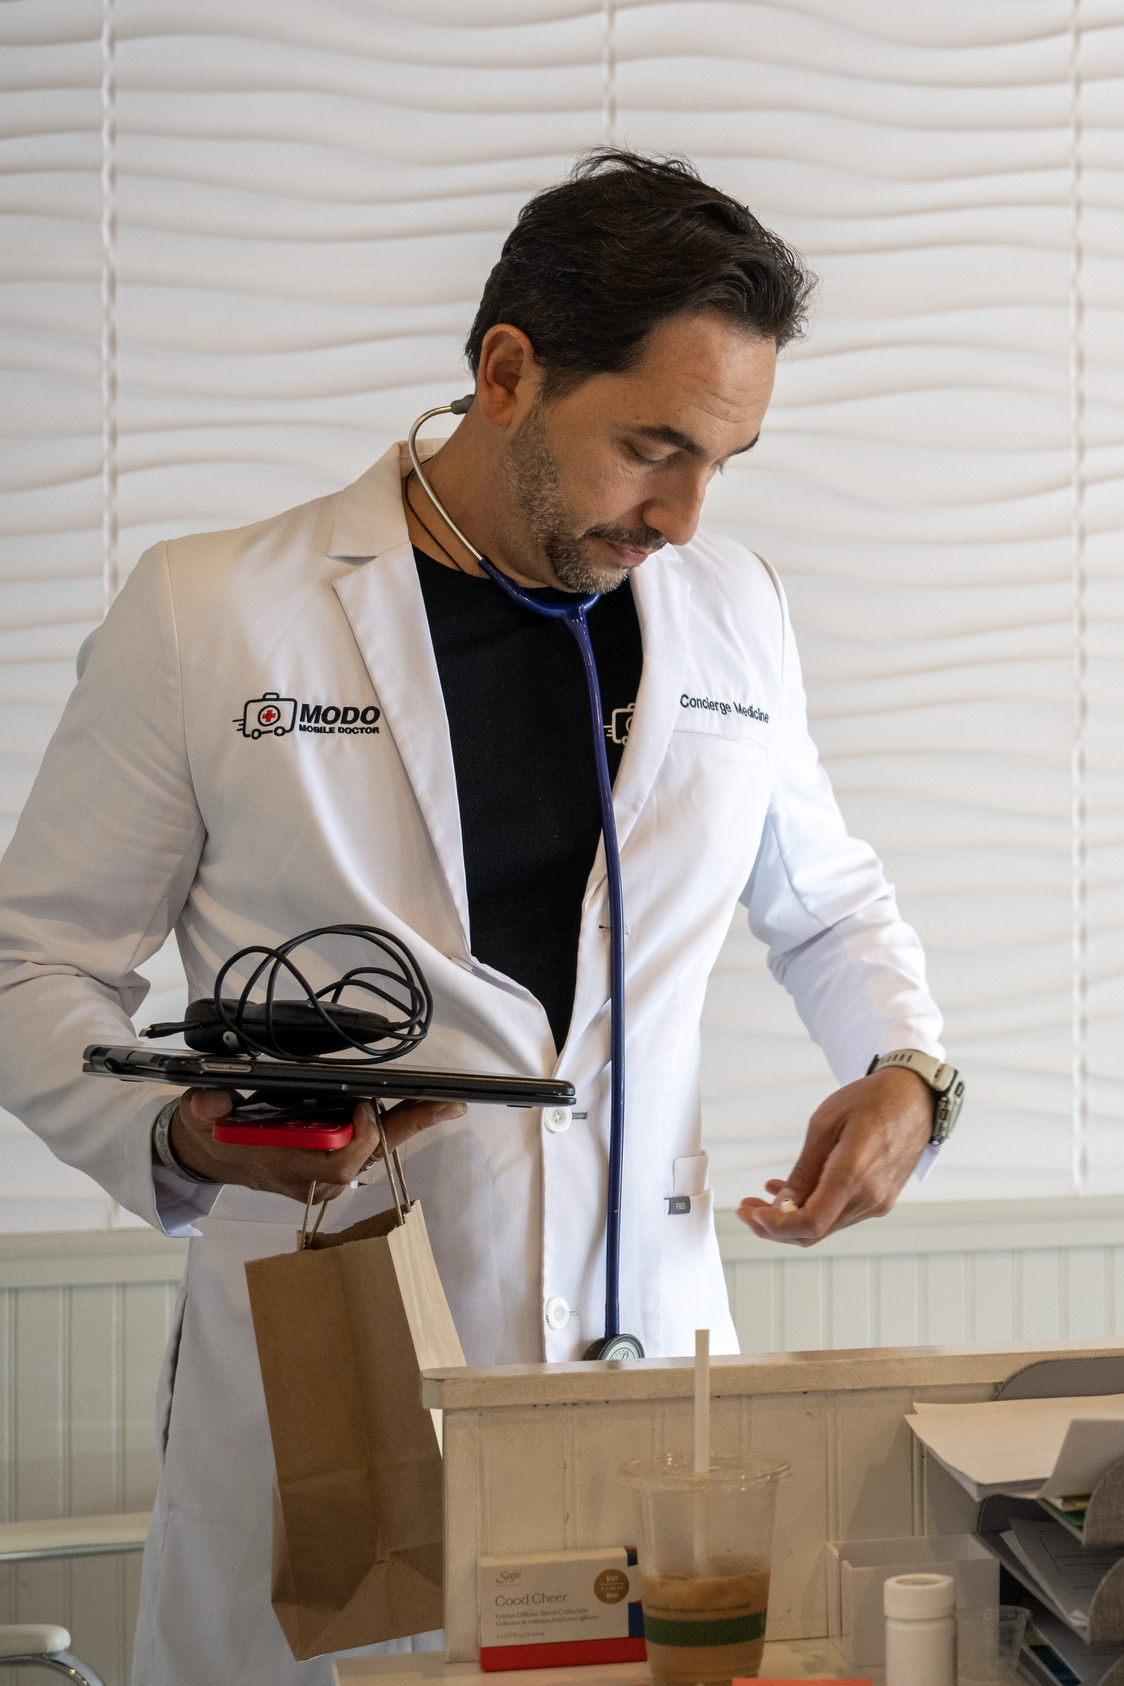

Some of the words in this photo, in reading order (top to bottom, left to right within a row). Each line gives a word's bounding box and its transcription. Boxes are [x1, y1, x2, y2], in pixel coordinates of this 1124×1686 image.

[299, 703, 381, 725] MODO
[680, 694, 732, 715] Concierge
[733, 701, 769, 723] Medicine
[299, 724, 336, 734] MOBILE
[338, 726, 380, 734] DOCTOR
[676, 1202, 686, 1210] FIGS
[495, 1594, 529, 1606] Good
[532, 1593, 567, 1604] Cheer
